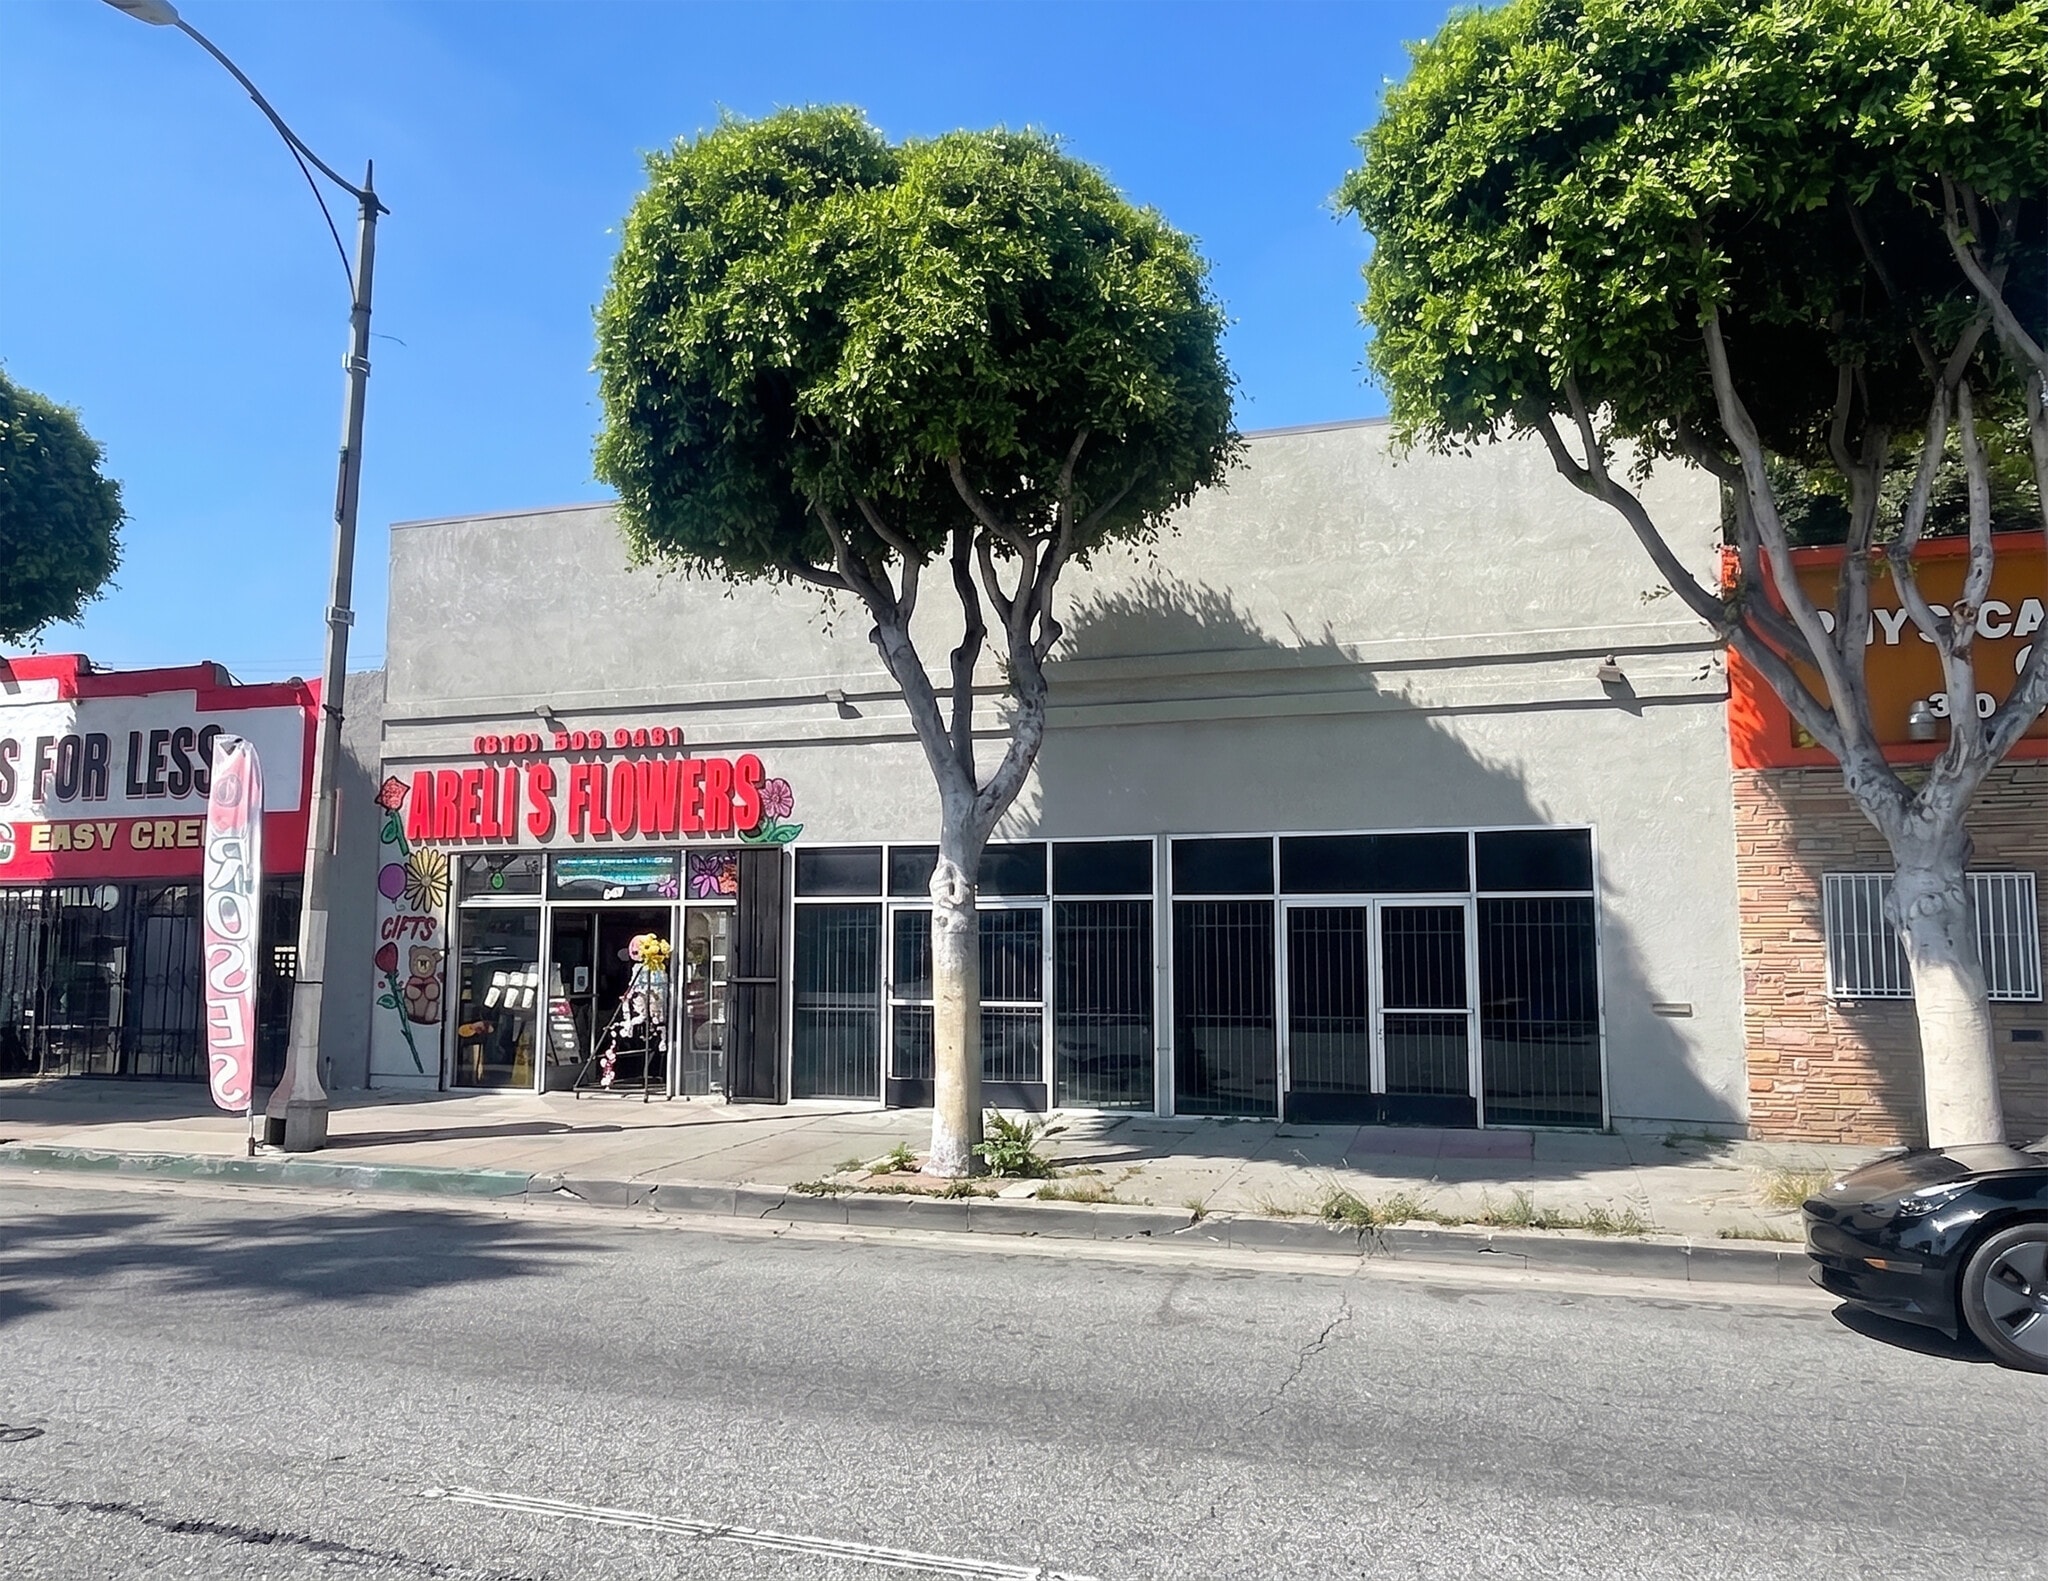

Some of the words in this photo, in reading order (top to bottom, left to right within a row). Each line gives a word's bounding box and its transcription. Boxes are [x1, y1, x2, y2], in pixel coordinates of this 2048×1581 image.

[1928, 692, 1997, 719] 30
[32, 733, 110, 804] FOR
[126, 724, 224, 800] LESS
[406, 762, 554, 841] ARELI'S
[568, 753, 763, 838] FLOWERS
[30, 822, 118, 853] EASY
[130, 819, 206, 850] CRE
